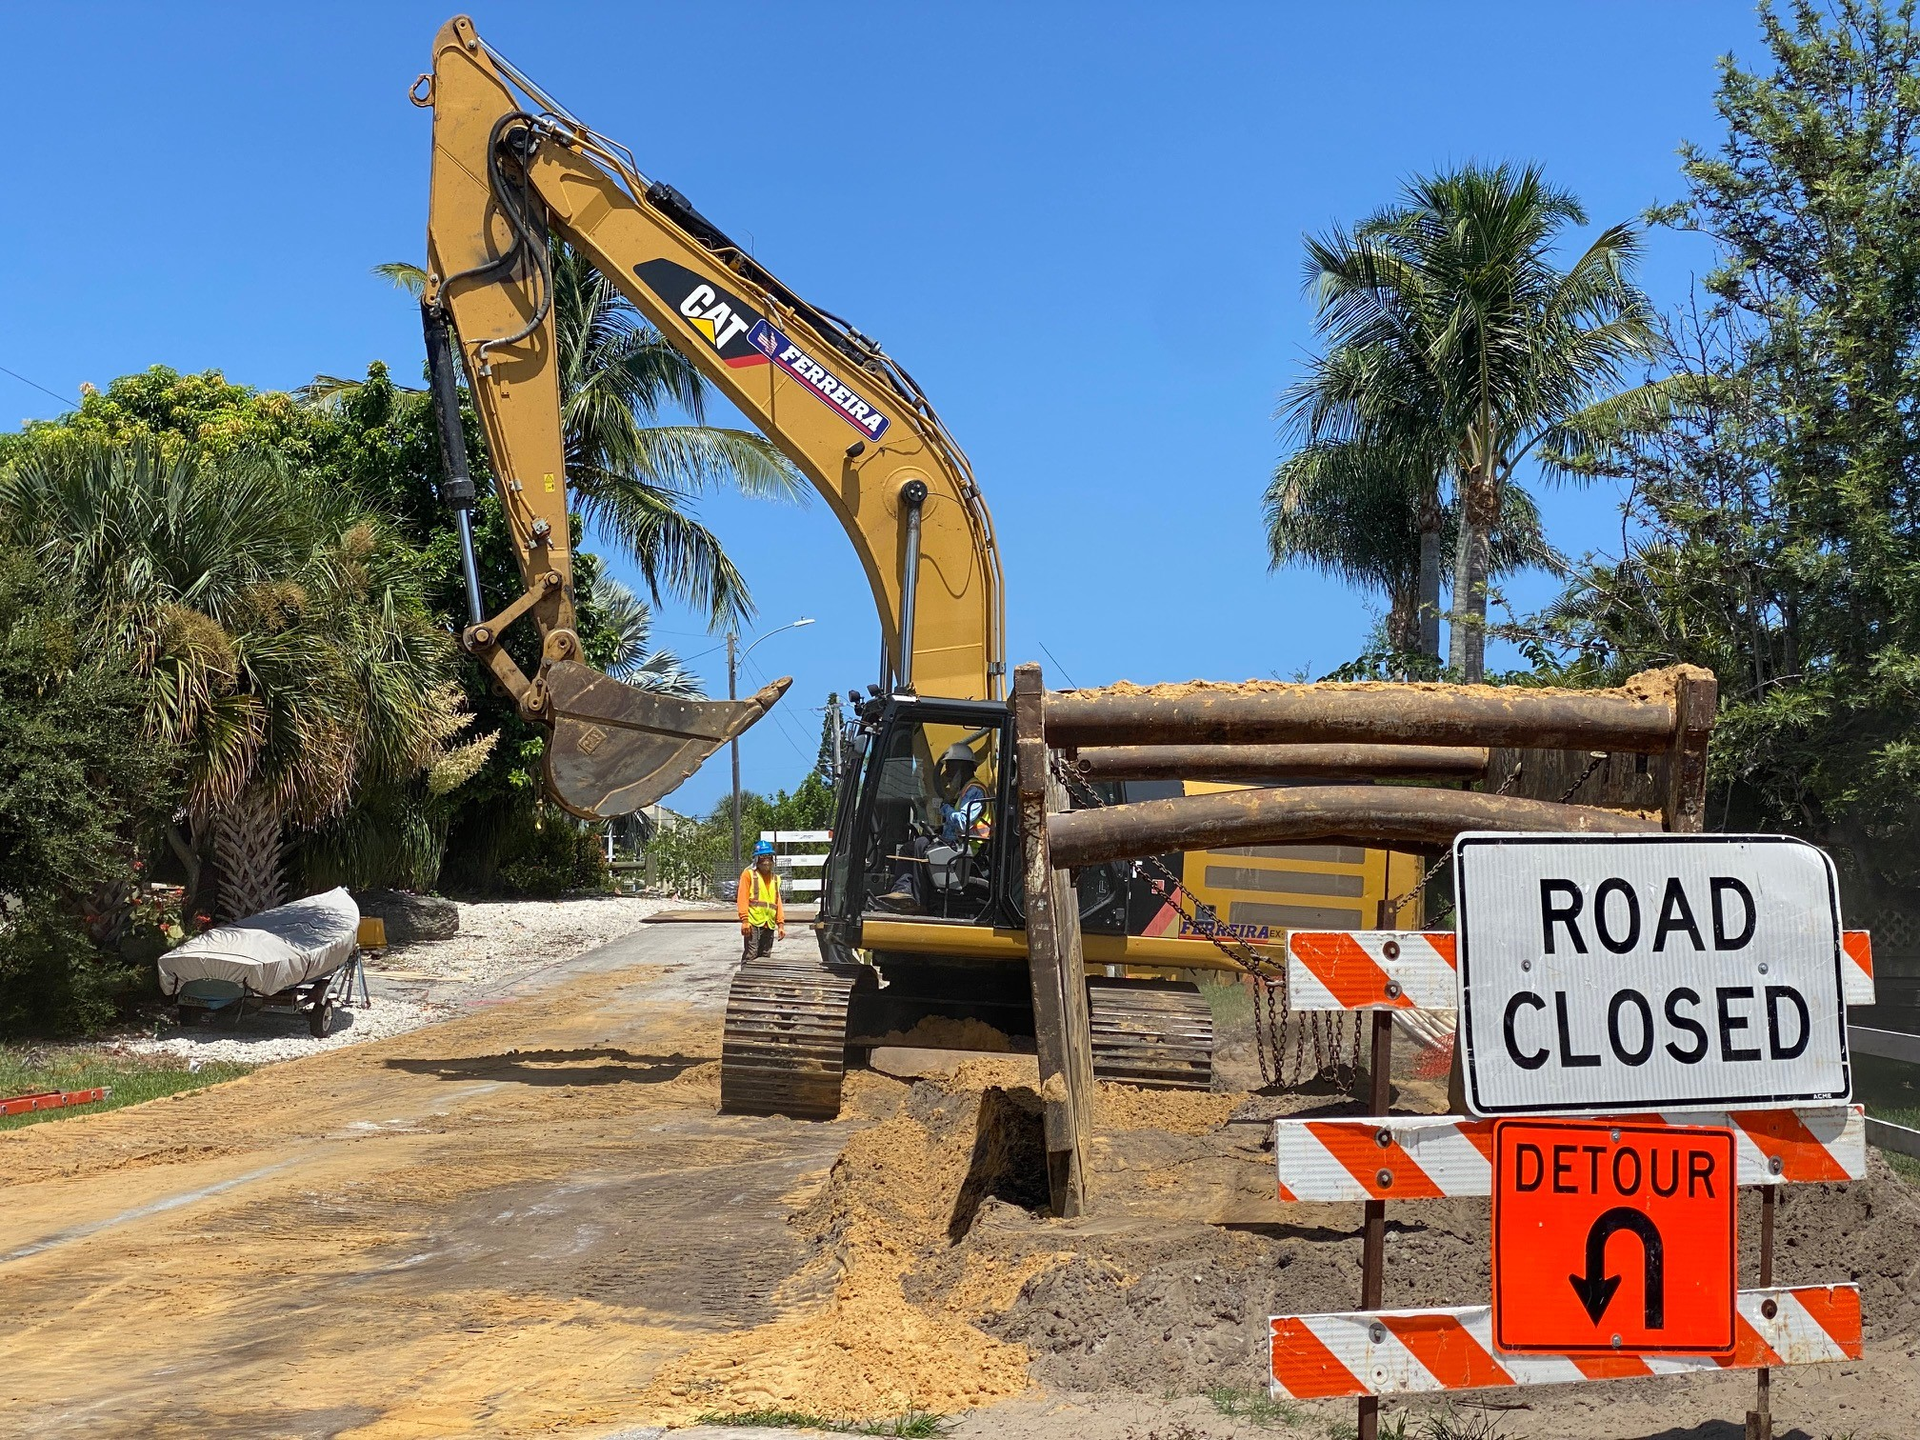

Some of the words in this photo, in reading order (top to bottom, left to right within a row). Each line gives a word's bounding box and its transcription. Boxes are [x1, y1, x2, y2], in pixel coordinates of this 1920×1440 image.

[680, 284, 749, 349] CAT
[779, 345, 883, 433] FERREIRA
[1539, 876, 1757, 954] ROAD
[1503, 985, 1811, 1070] CLOSED
[1515, 1143, 1716, 1198] DETOUR
